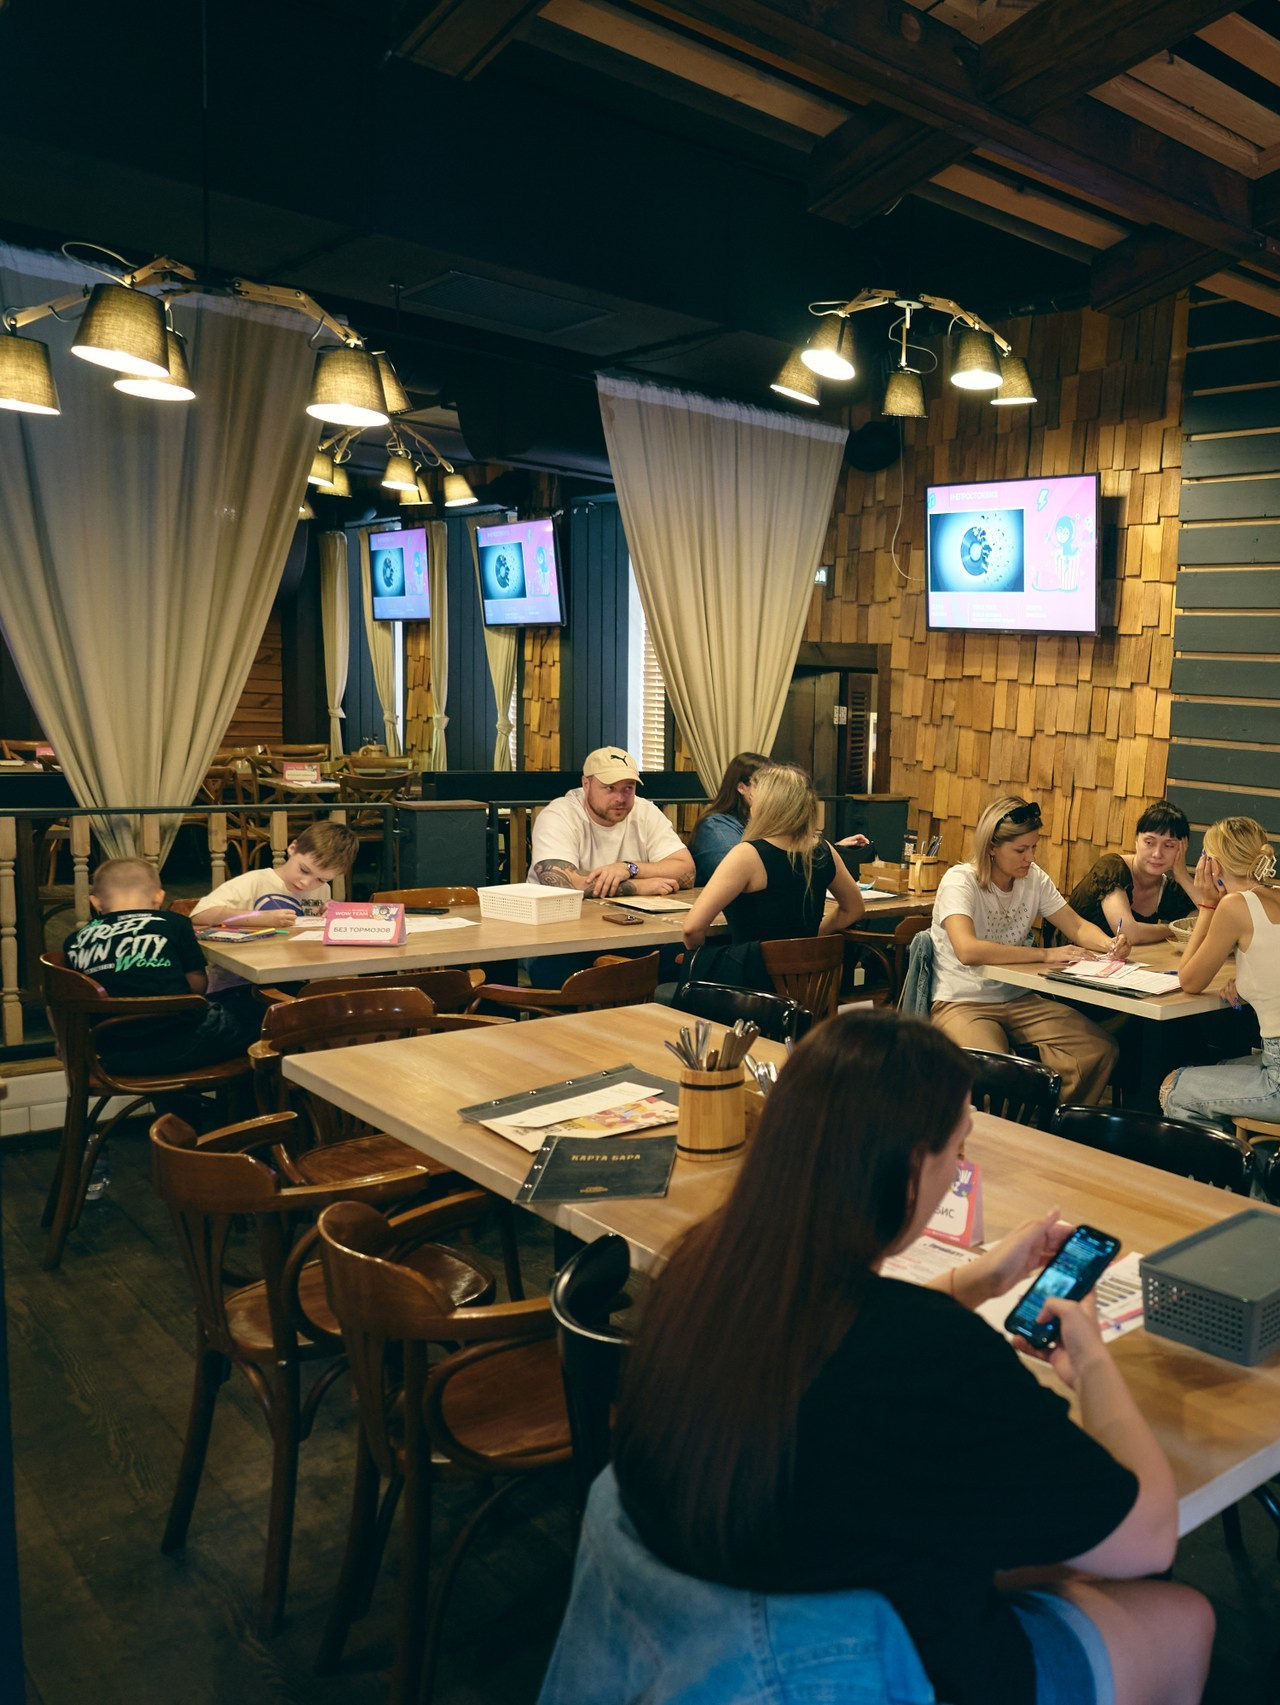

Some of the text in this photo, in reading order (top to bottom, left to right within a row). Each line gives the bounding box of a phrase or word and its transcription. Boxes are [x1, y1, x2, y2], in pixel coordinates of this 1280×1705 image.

[115, 933, 168, 960] CITY
[571, 1153, 641, 1161] КАРТА БАРА
